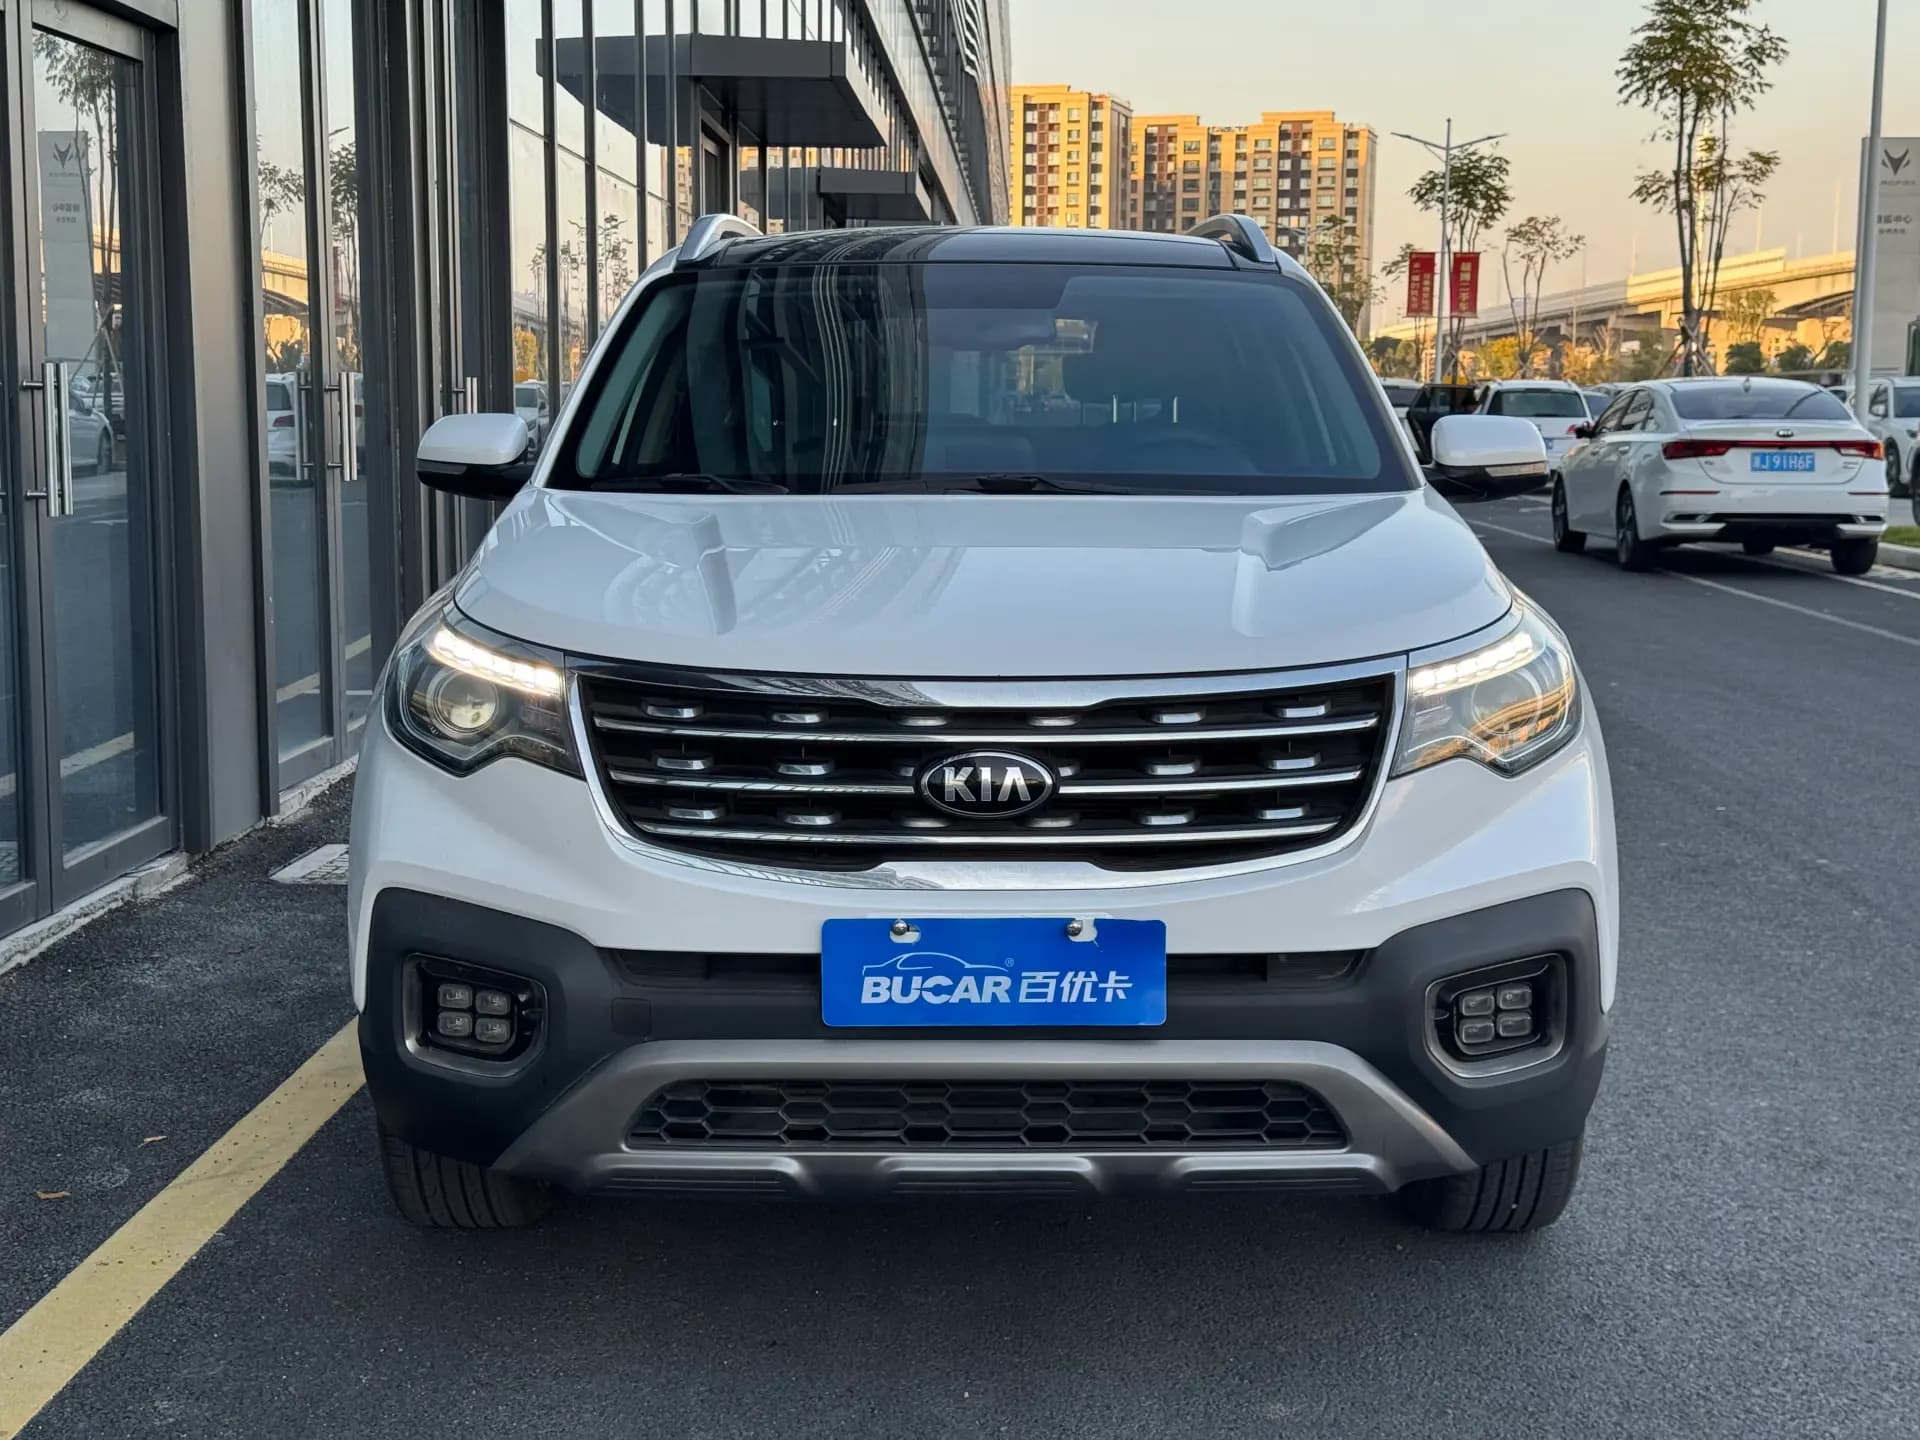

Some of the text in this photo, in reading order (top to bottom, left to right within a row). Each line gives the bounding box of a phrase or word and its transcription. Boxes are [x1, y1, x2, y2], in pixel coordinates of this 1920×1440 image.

[944, 766, 1031, 802] KIA
[861, 970, 1133, 1003] BUCAR 百优卡
